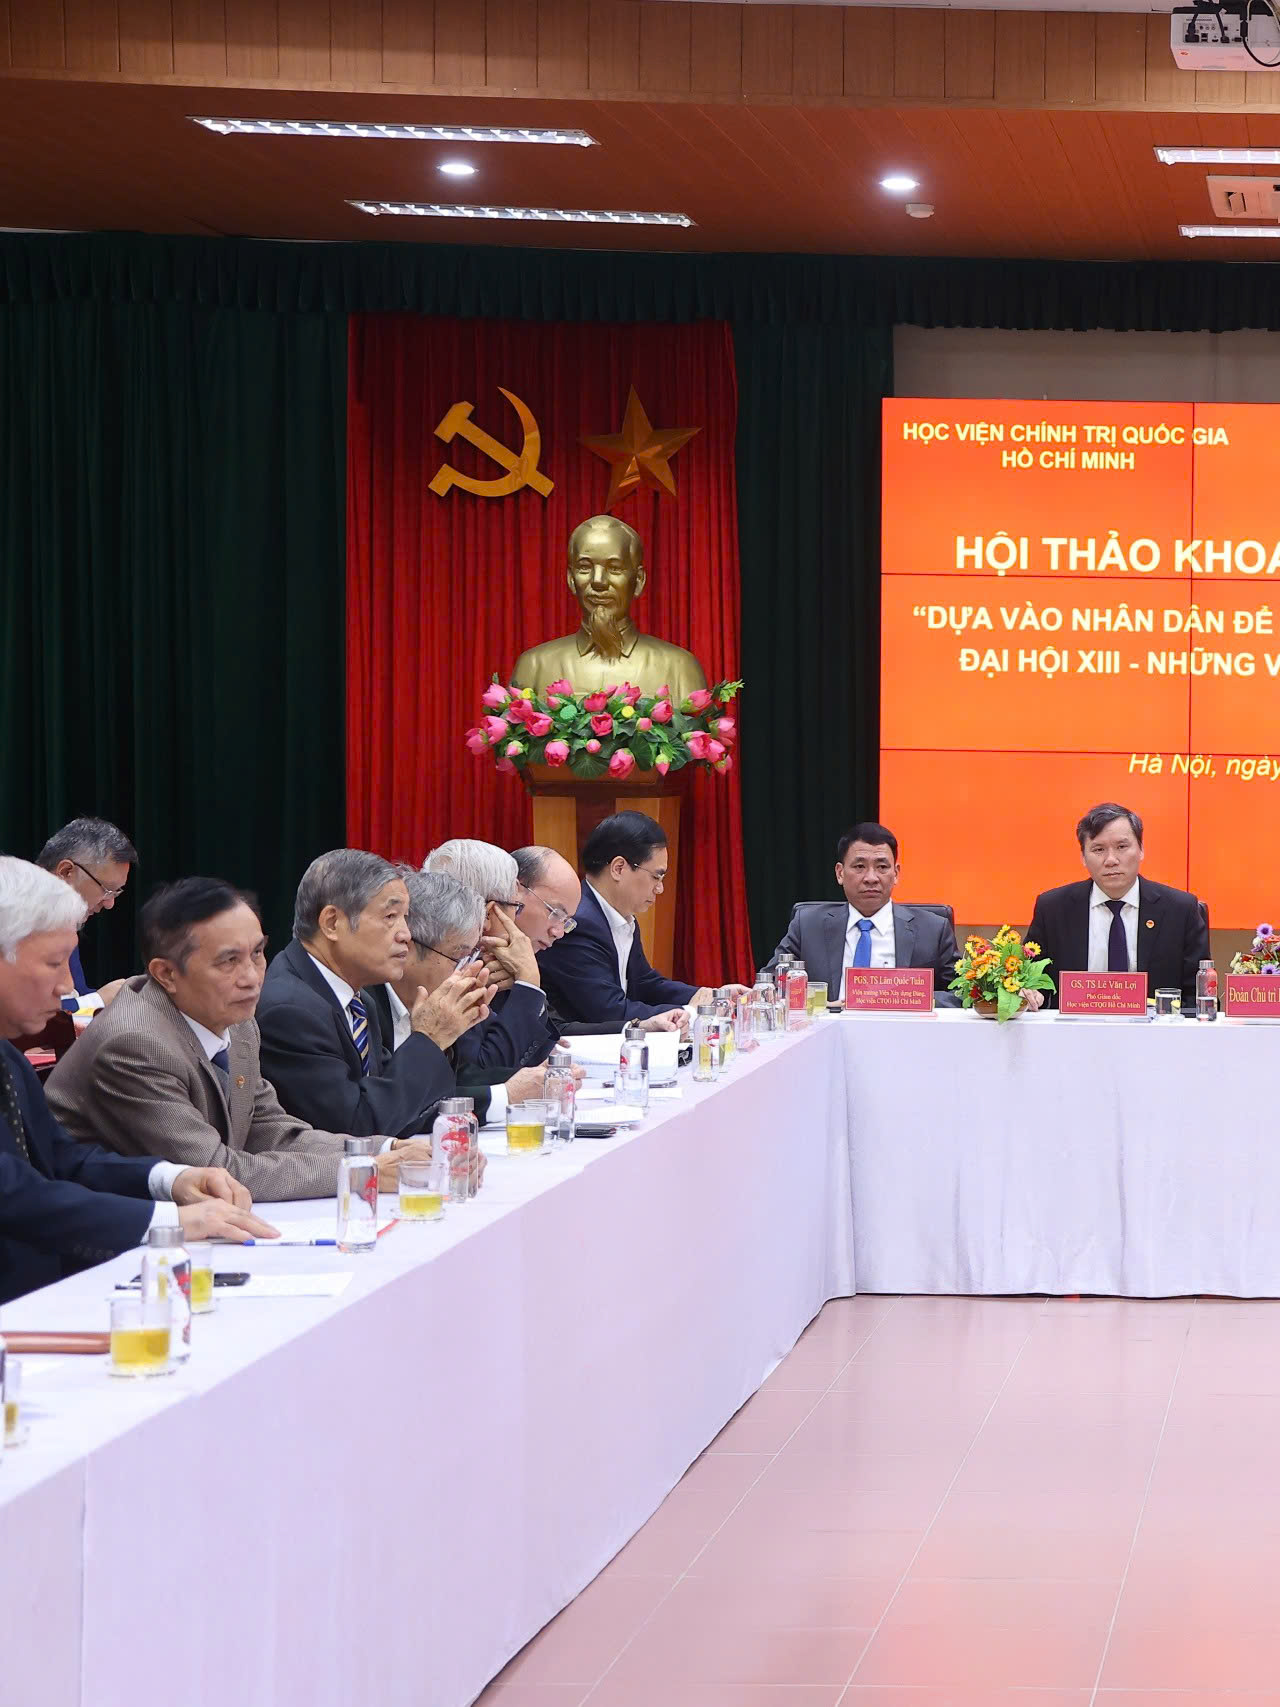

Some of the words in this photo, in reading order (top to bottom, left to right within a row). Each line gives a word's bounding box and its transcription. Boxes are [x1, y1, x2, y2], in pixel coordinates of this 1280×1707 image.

[903, 422, 950, 445] HỌC
[954, 421, 1004, 446] VIỆN
[1010, 420, 1077, 443] CHÍNH
[1082, 425, 1117, 448] TRỊ
[1122, 423, 1185, 445] QUỐC
[1193, 427, 1230, 446] GIA
[1002, 446, 1034, 468] HỒ
[1039, 447, 1076, 469] CHÍ
[1081, 451, 1135, 470] MINH
[956, 530, 1029, 577] HỘI
[1041, 529, 1161, 573] THẢO
[999, 600, 1063, 632] VÀO
[1071, 602, 1154, 633] NHÂN
[1163, 604, 1225, 634] DÂN
[1232, 605, 1274, 635] ĐỂ
[958, 648, 1009, 679] ĐẠI
[1018, 645, 1069, 679] HỘI
[1076, 649, 1121, 674] XIII
[1147, 646, 1256, 677] NHỮNG
[1128, 753, 1163, 774] Hà
[1170, 753, 1216, 778] Nội,
[870, 976, 877, 984] TS
[879, 976, 892, 984] Lâm
[894, 975, 909, 986] Quốc
[1086, 980, 1096, 988] TS
[1097, 980, 1107, 988] Lê
[1109, 980, 1123, 988] Văn
[1125, 980, 1136, 990] Lợi
[1229, 987, 1249, 1002] Đoàn
[1251, 987, 1266, 1002] Chủ
[1267, 987, 1276, 1002] trì
